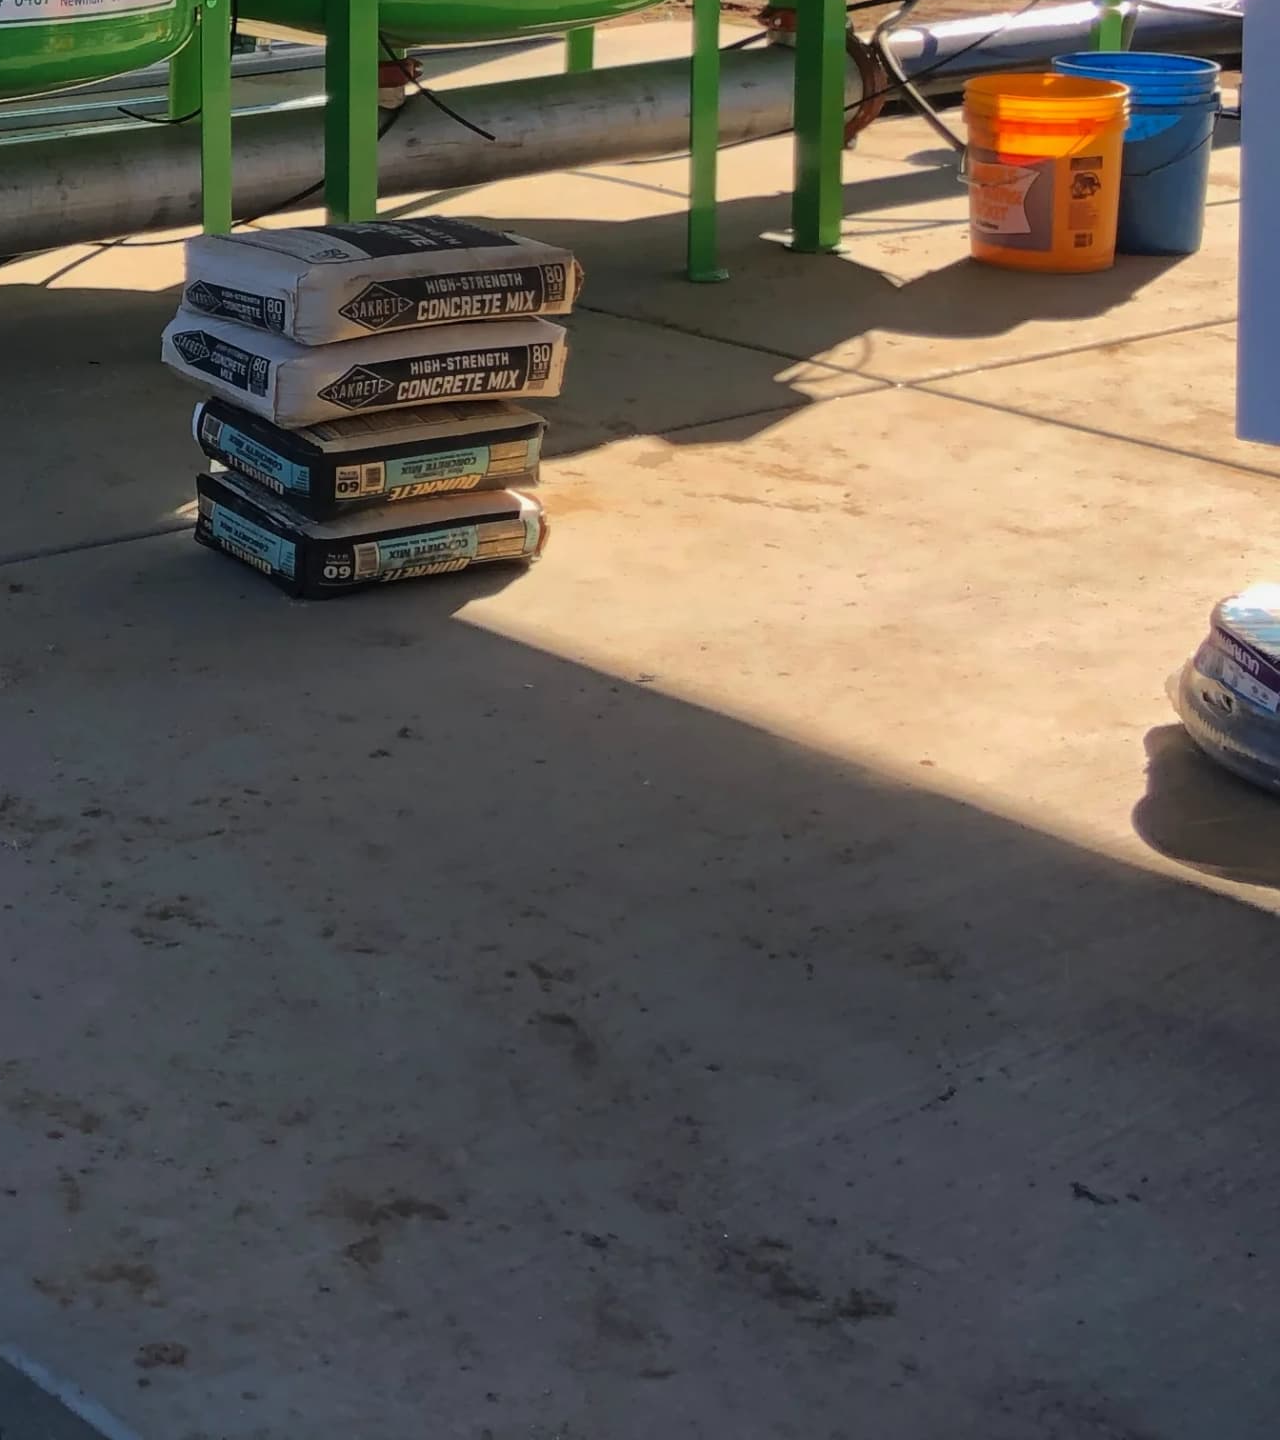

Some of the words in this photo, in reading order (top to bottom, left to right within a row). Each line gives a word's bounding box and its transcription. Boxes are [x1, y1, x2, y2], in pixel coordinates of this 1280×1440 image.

[425, 272, 523, 294] HIGH-STRENGTH
[544, 264, 564, 283] 80
[222, 300, 262, 319] CONCRETE
[267, 299, 283, 314] 80
[351, 296, 404, 319] SAKRETE
[416, 293, 503, 321] CONCRETE
[505, 290, 536, 312] MIX
[177, 334, 207, 356] SAKRETE
[532, 344, 550, 362] 80
[211, 352, 247, 376] CONCRETE
[253, 358, 268, 373] 80
[410, 352, 509, 375] HIGH-STRENGTH
[220, 368, 233, 381] MIX
[330, 377, 385, 401] SAKRETE
[396, 373, 484, 401] CONCRETE
[487, 369, 520, 392] MIX
[400, 463, 423, 475] MIX
[426, 456, 477, 471] CONCRETE
[337, 481, 359, 493] 60
[386, 474, 481, 502] QUIKRETE
[389, 548, 411, 560] MIX
[324, 565, 351, 579] 60
